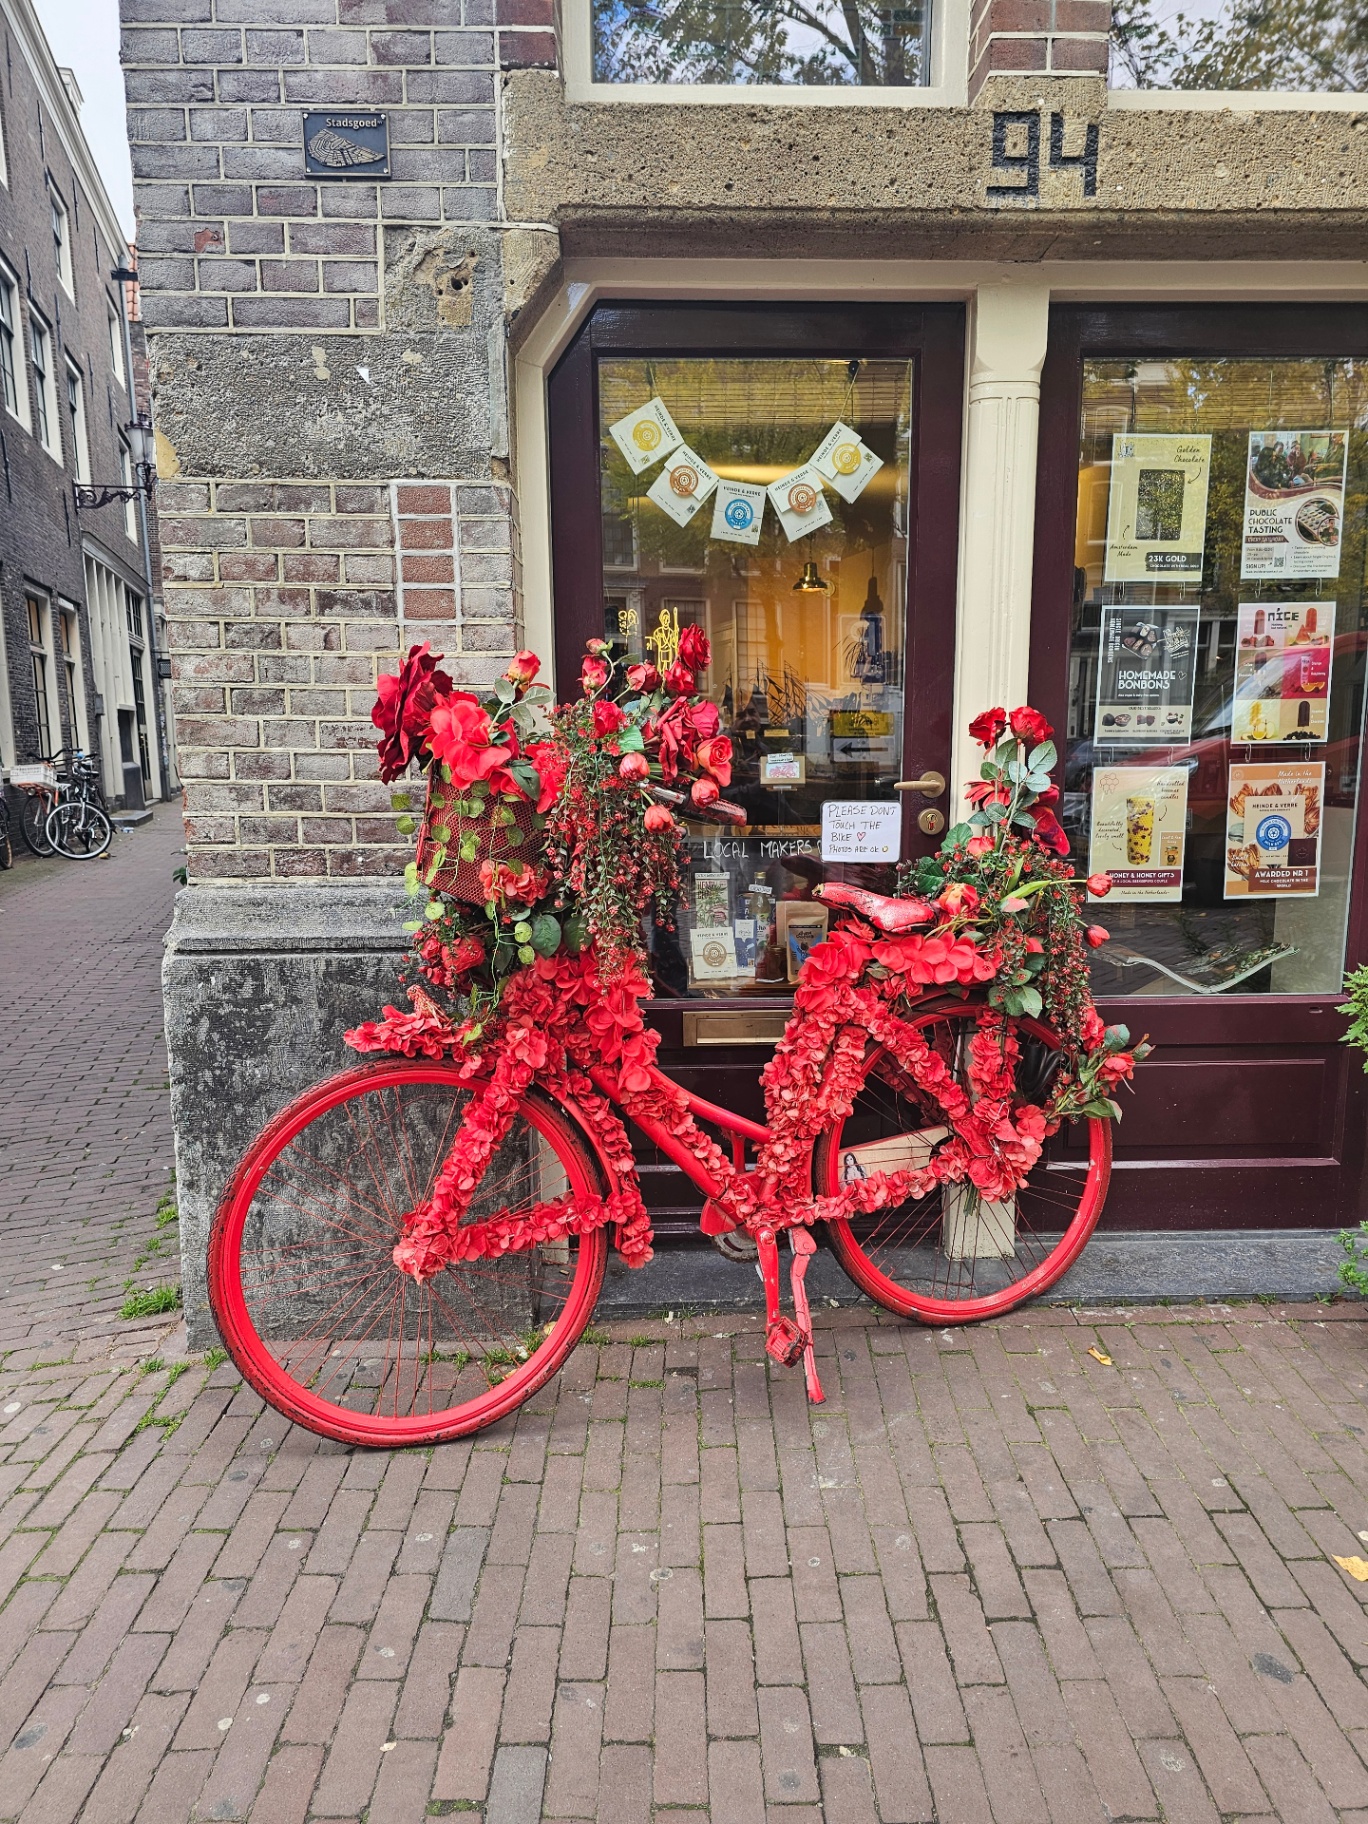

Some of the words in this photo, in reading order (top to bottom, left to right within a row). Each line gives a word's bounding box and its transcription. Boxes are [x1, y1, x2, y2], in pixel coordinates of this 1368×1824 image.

[326, 118, 377, 130] Stadsgoed
[986, 111, 1100, 197] 94
[1119, 670, 1176, 680] HOMEMADE
[1118, 680, 1170, 689] BONBONS
[828, 804, 867, 817] PLEASE
[829, 820, 855, 830] TOUCH
[860, 821, 882, 830] THE
[831, 832, 852, 842] BIKE
[703, 841, 749, 859] LOCAL
[760, 840, 812, 858] MAKERS
[829, 844, 852, 853] PHOTOS
